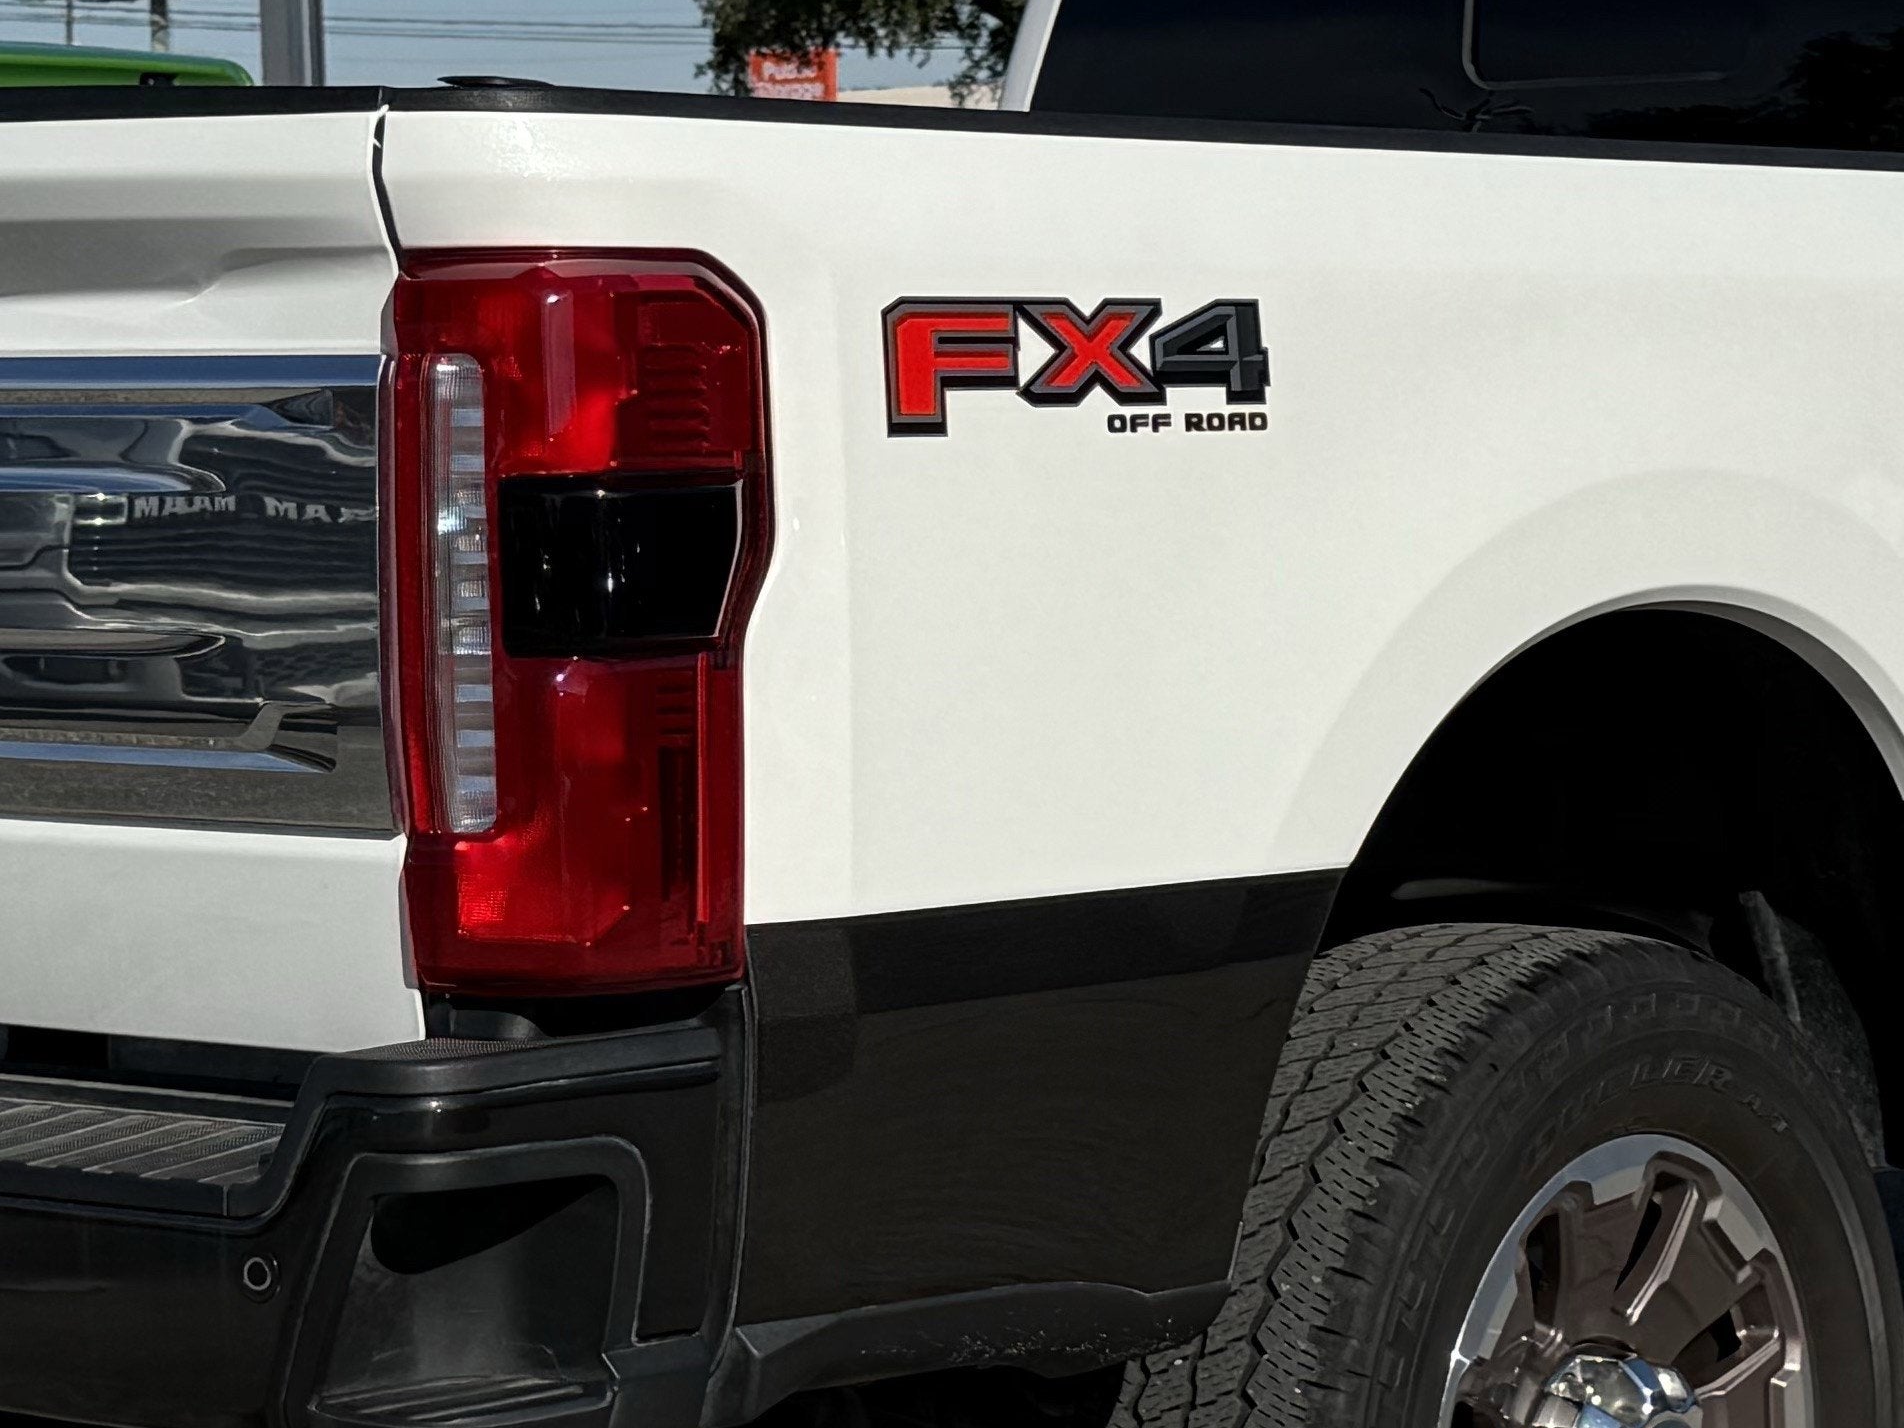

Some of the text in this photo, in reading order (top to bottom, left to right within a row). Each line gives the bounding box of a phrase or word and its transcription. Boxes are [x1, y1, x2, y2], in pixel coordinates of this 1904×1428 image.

[881, 295, 1271, 438] FX4
[1107, 412, 1268, 433] OFF ROAD
